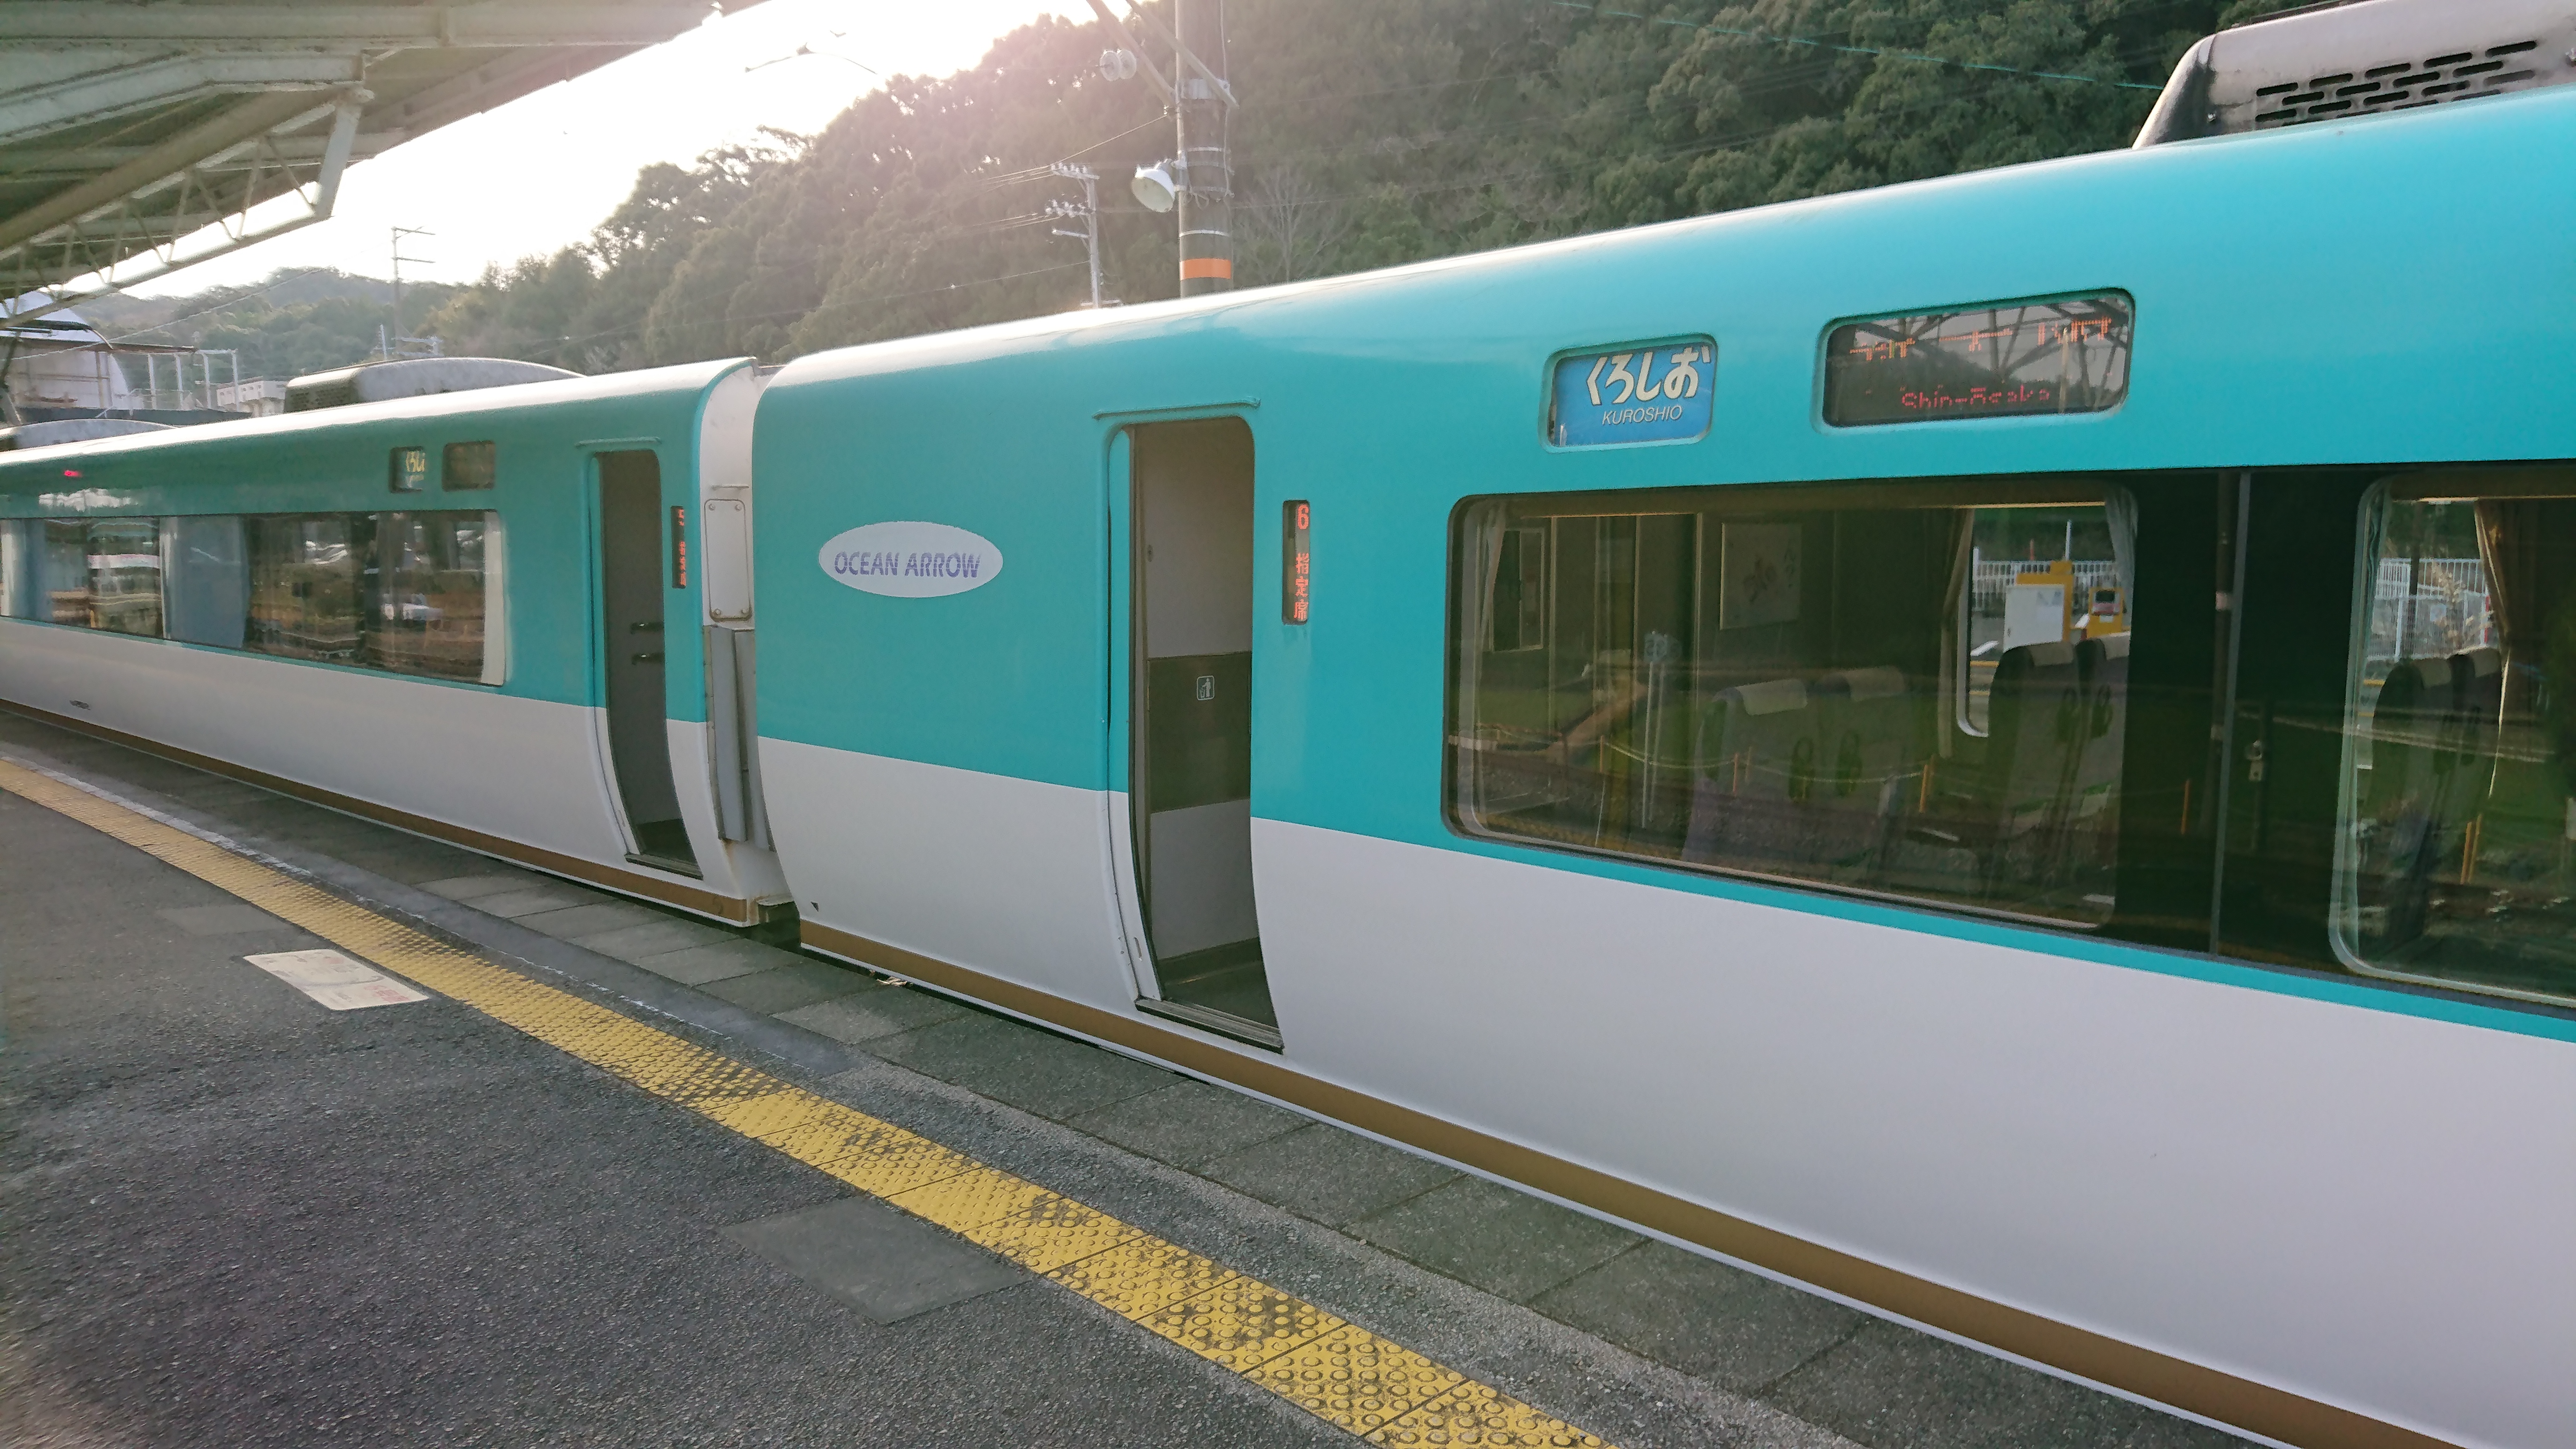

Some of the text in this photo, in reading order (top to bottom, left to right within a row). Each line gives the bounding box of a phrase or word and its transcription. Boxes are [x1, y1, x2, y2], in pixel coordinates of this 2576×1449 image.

[1587, 345, 1711, 406] くろしお
[1602, 404, 1683, 425] KUROSHIO
[834, 551, 981, 578] OCEAN ARROW
[1294, 504, 1310, 621] 6 指定席
